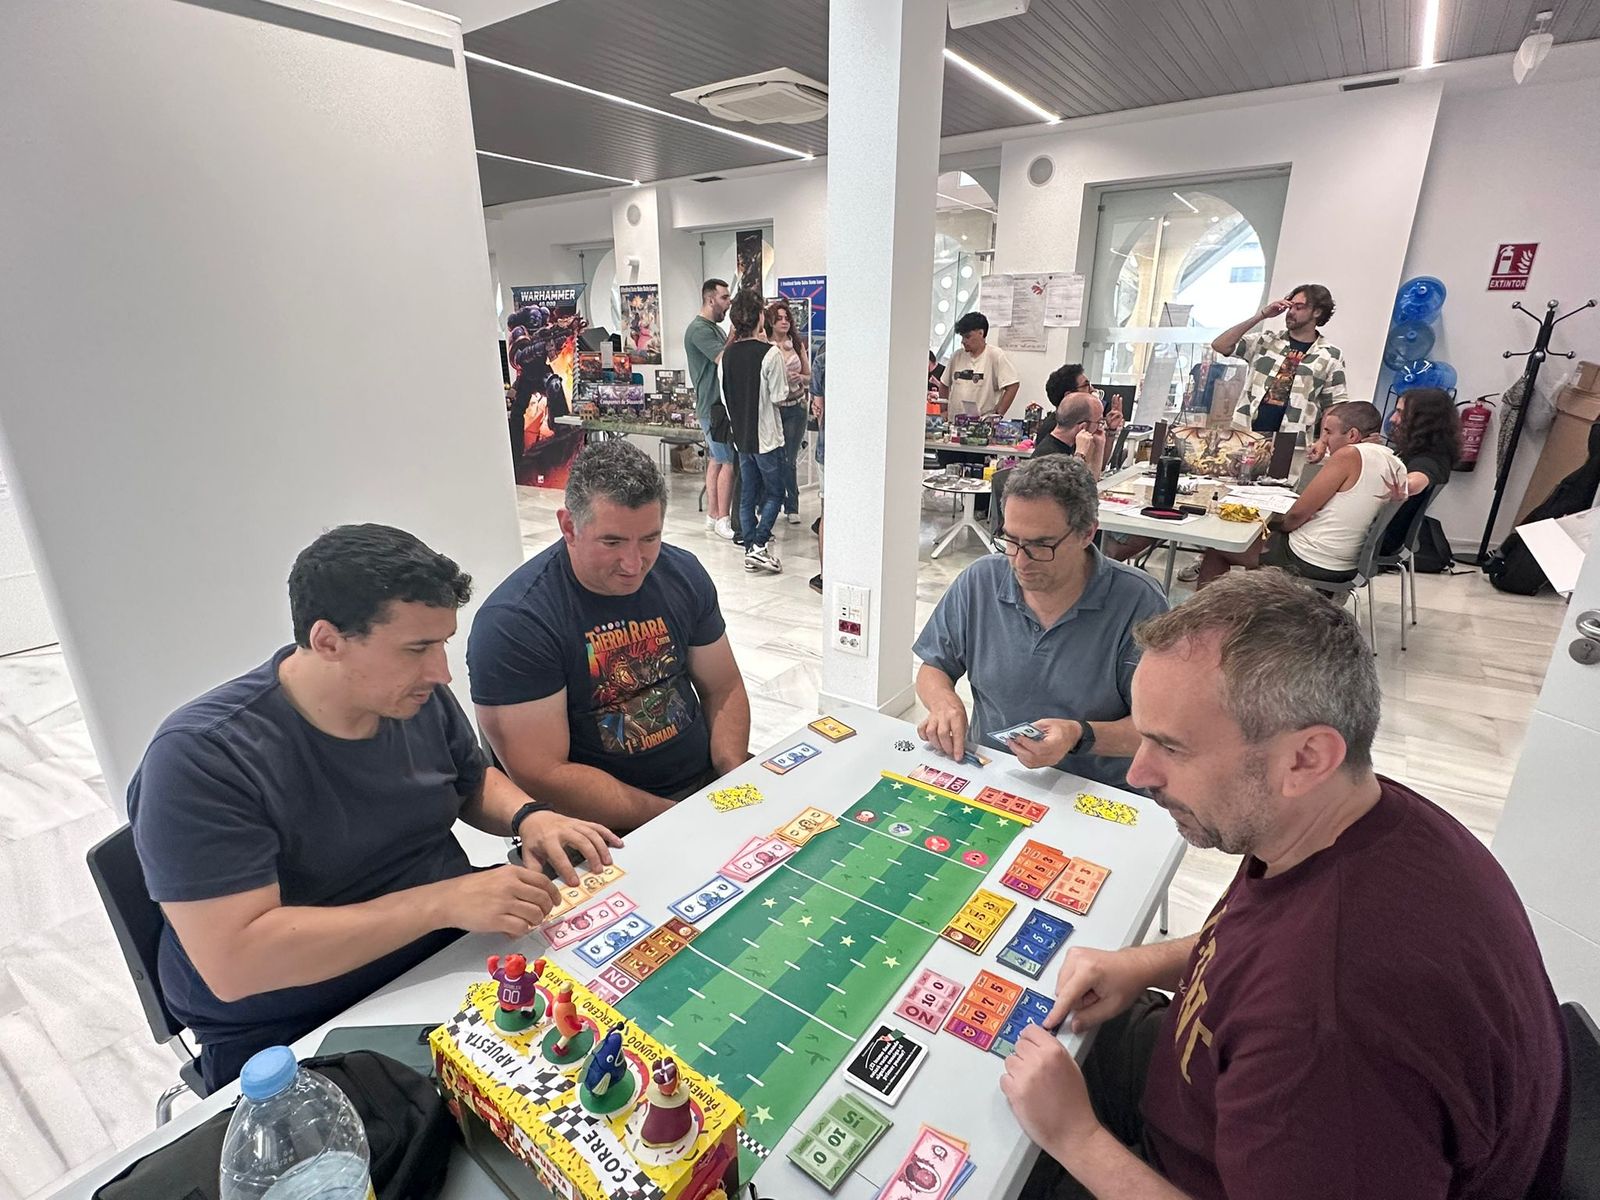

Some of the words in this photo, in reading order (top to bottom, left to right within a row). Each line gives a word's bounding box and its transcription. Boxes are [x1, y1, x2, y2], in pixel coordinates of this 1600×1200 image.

[1489, 279, 1526, 288] EXTINTOR
[520, 289, 576, 302] WARHAMMER
[585, 627, 632, 652] TIERRA
[628, 616, 668, 643] RARA
[640, 723, 679, 751] JORNADA
[982, 901, 995, 910] 3
[964, 922, 976, 931] 7
[1041, 922, 1053, 933] 3
[1032, 932, 1044, 944] 5
[1022, 944, 1035, 955] 7
[604, 969, 630, 989] NO
[933, 981, 945, 990] 0
[990, 982, 1004, 993] 5
[502, 988, 520, 1005] 00
[921, 993, 937, 1008] 10
[981, 997, 995, 1007] 7
[1035, 1001, 1048, 1014] 5
[905, 1005, 934, 1026] NO
[971, 1009, 988, 1026] 10
[464, 1032, 516, 1068] APUESTA
[506, 1066, 523, 1079] Y
[827, 1127, 847, 1147] 10
[582, 1129, 629, 1184] CORRE
[813, 1151, 827, 1164] 0
[529, 1145, 568, 1192] APUESTA
